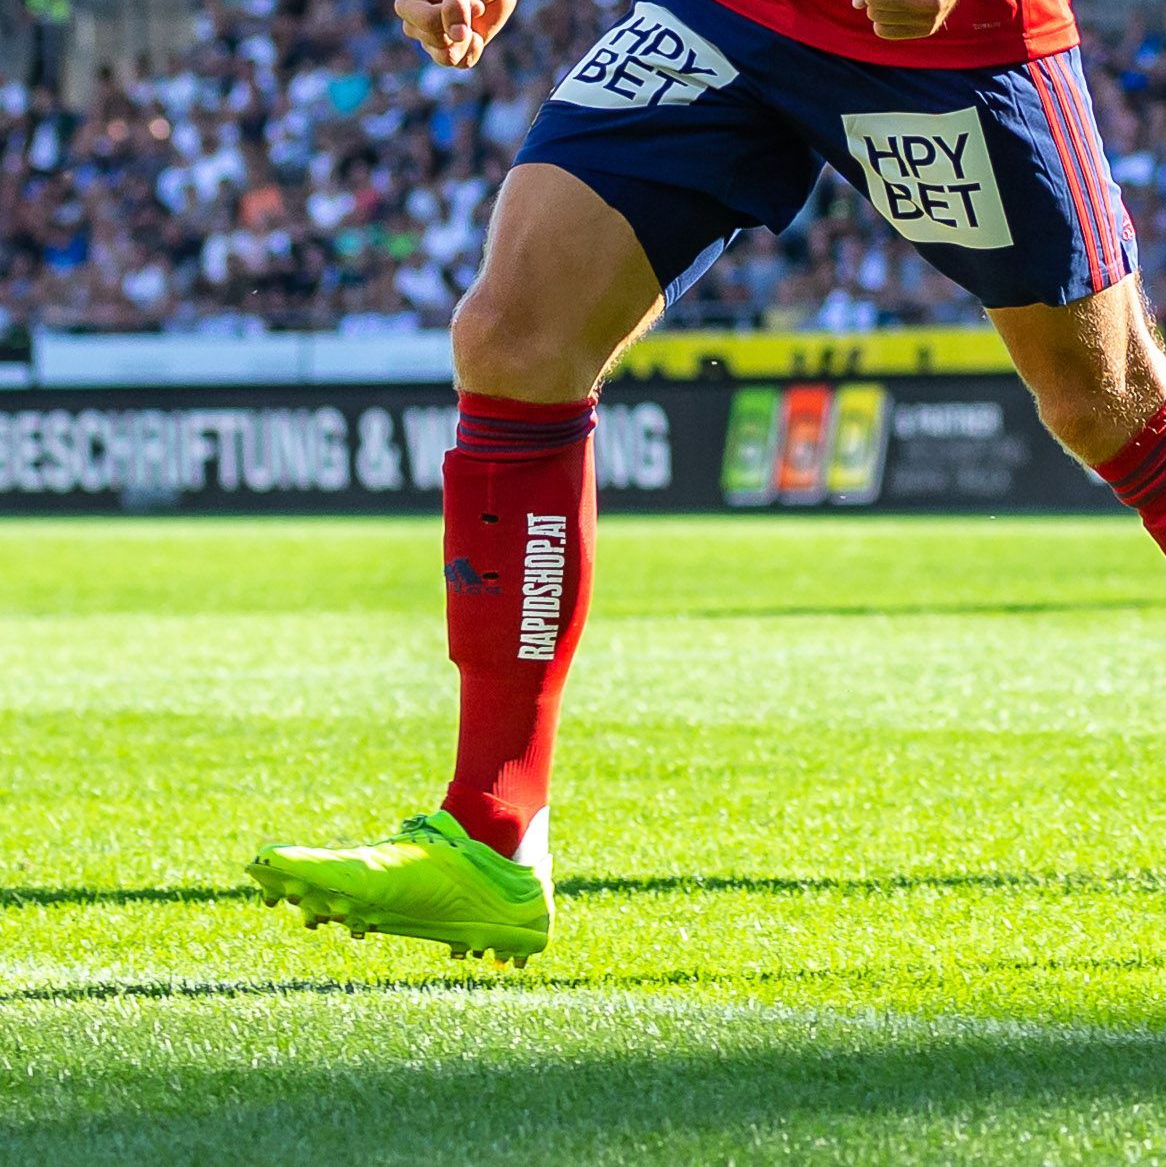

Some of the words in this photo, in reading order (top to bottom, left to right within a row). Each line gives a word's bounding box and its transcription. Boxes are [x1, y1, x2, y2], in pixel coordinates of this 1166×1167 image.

[609, 16, 718, 76] HPY
[573, 48, 689, 106] BET
[863, 132, 969, 180] HPY
[883, 181, 982, 228] BET
[517, 513, 567, 661] RAPIDSHOP.AT
